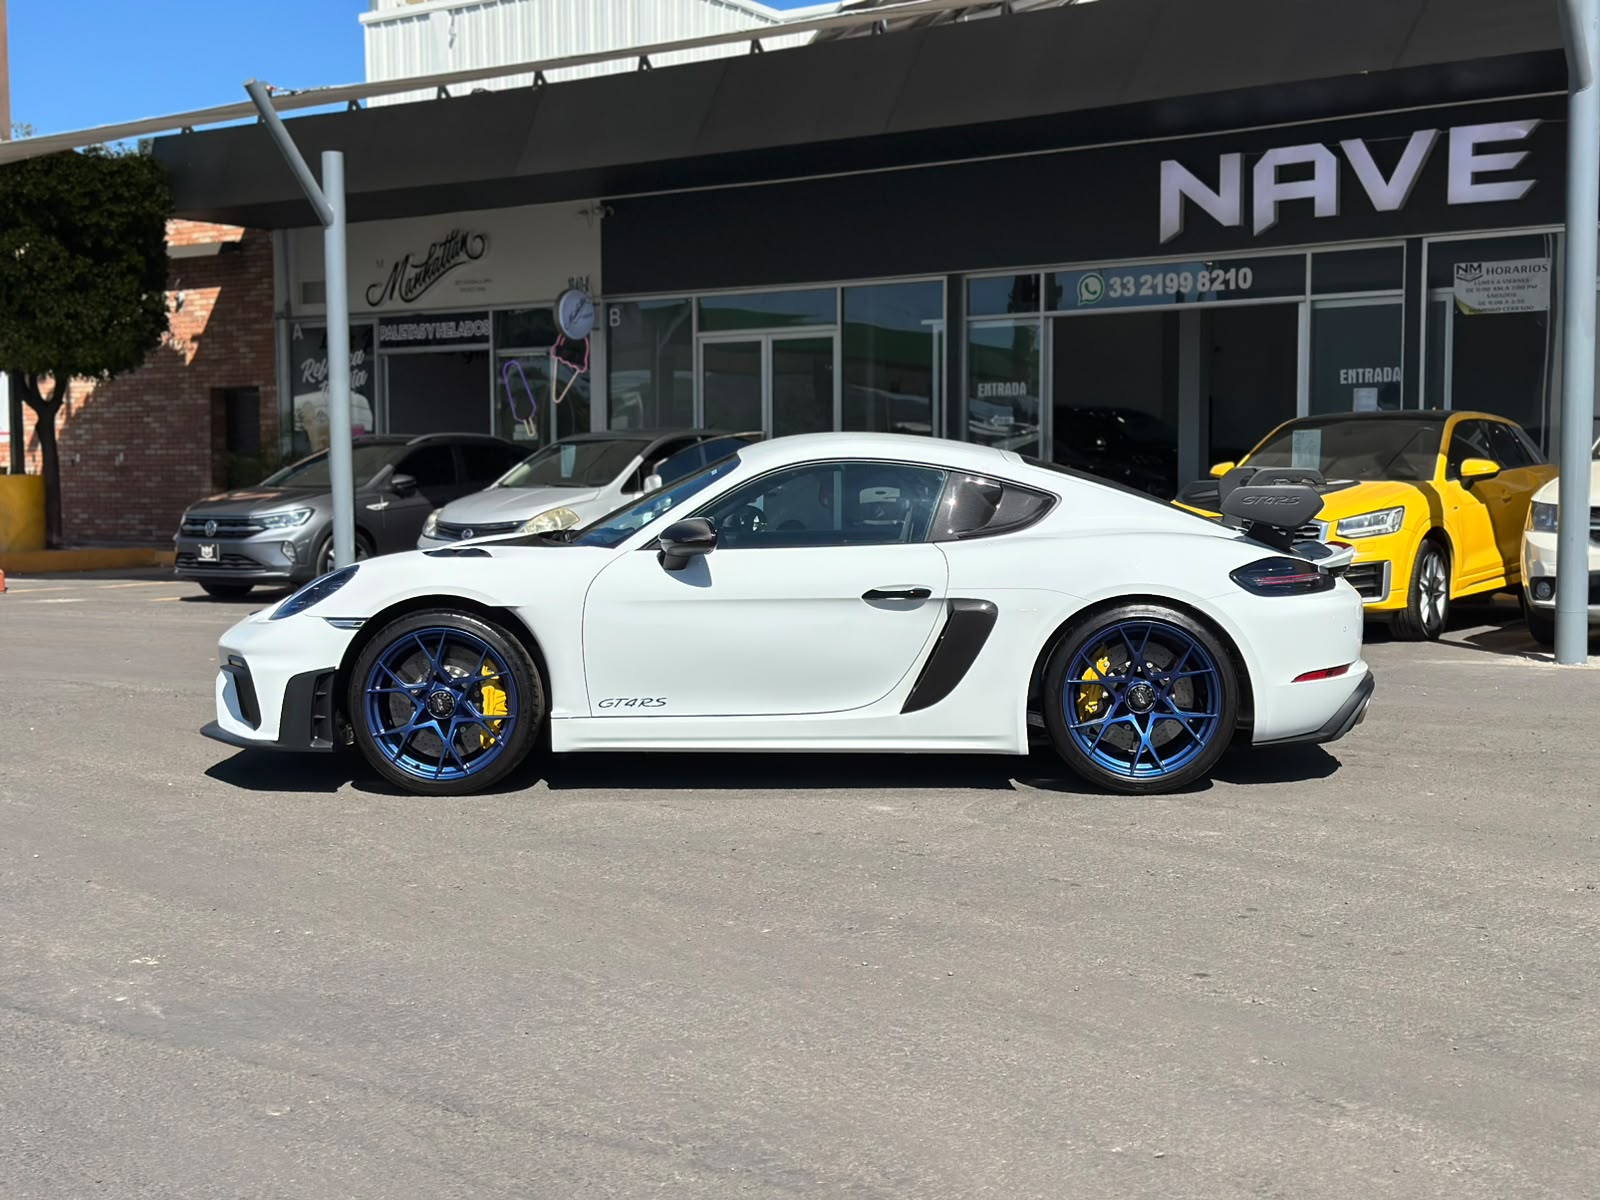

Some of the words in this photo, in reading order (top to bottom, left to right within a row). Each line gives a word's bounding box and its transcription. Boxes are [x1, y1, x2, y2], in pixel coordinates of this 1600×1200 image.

[1159, 118, 1543, 245] NAVE
[365, 228, 486, 307] Manhattan
[1456, 263, 1482, 275] NM
[1486, 264, 1549, 275] HORARIOS
[1109, 276, 1136, 298] 33
[1139, 271, 1194, 296] 2199
[1197, 267, 1253, 292] 8210
[608, 307, 622, 327] B
[292, 323, 304, 341] A
[436, 319, 490, 339] HELADOS
[1340, 366, 1401, 385] ENTRADA
[977, 381, 1027, 398] ENTRADA
[598, 697, 667, 709] GT4RS
